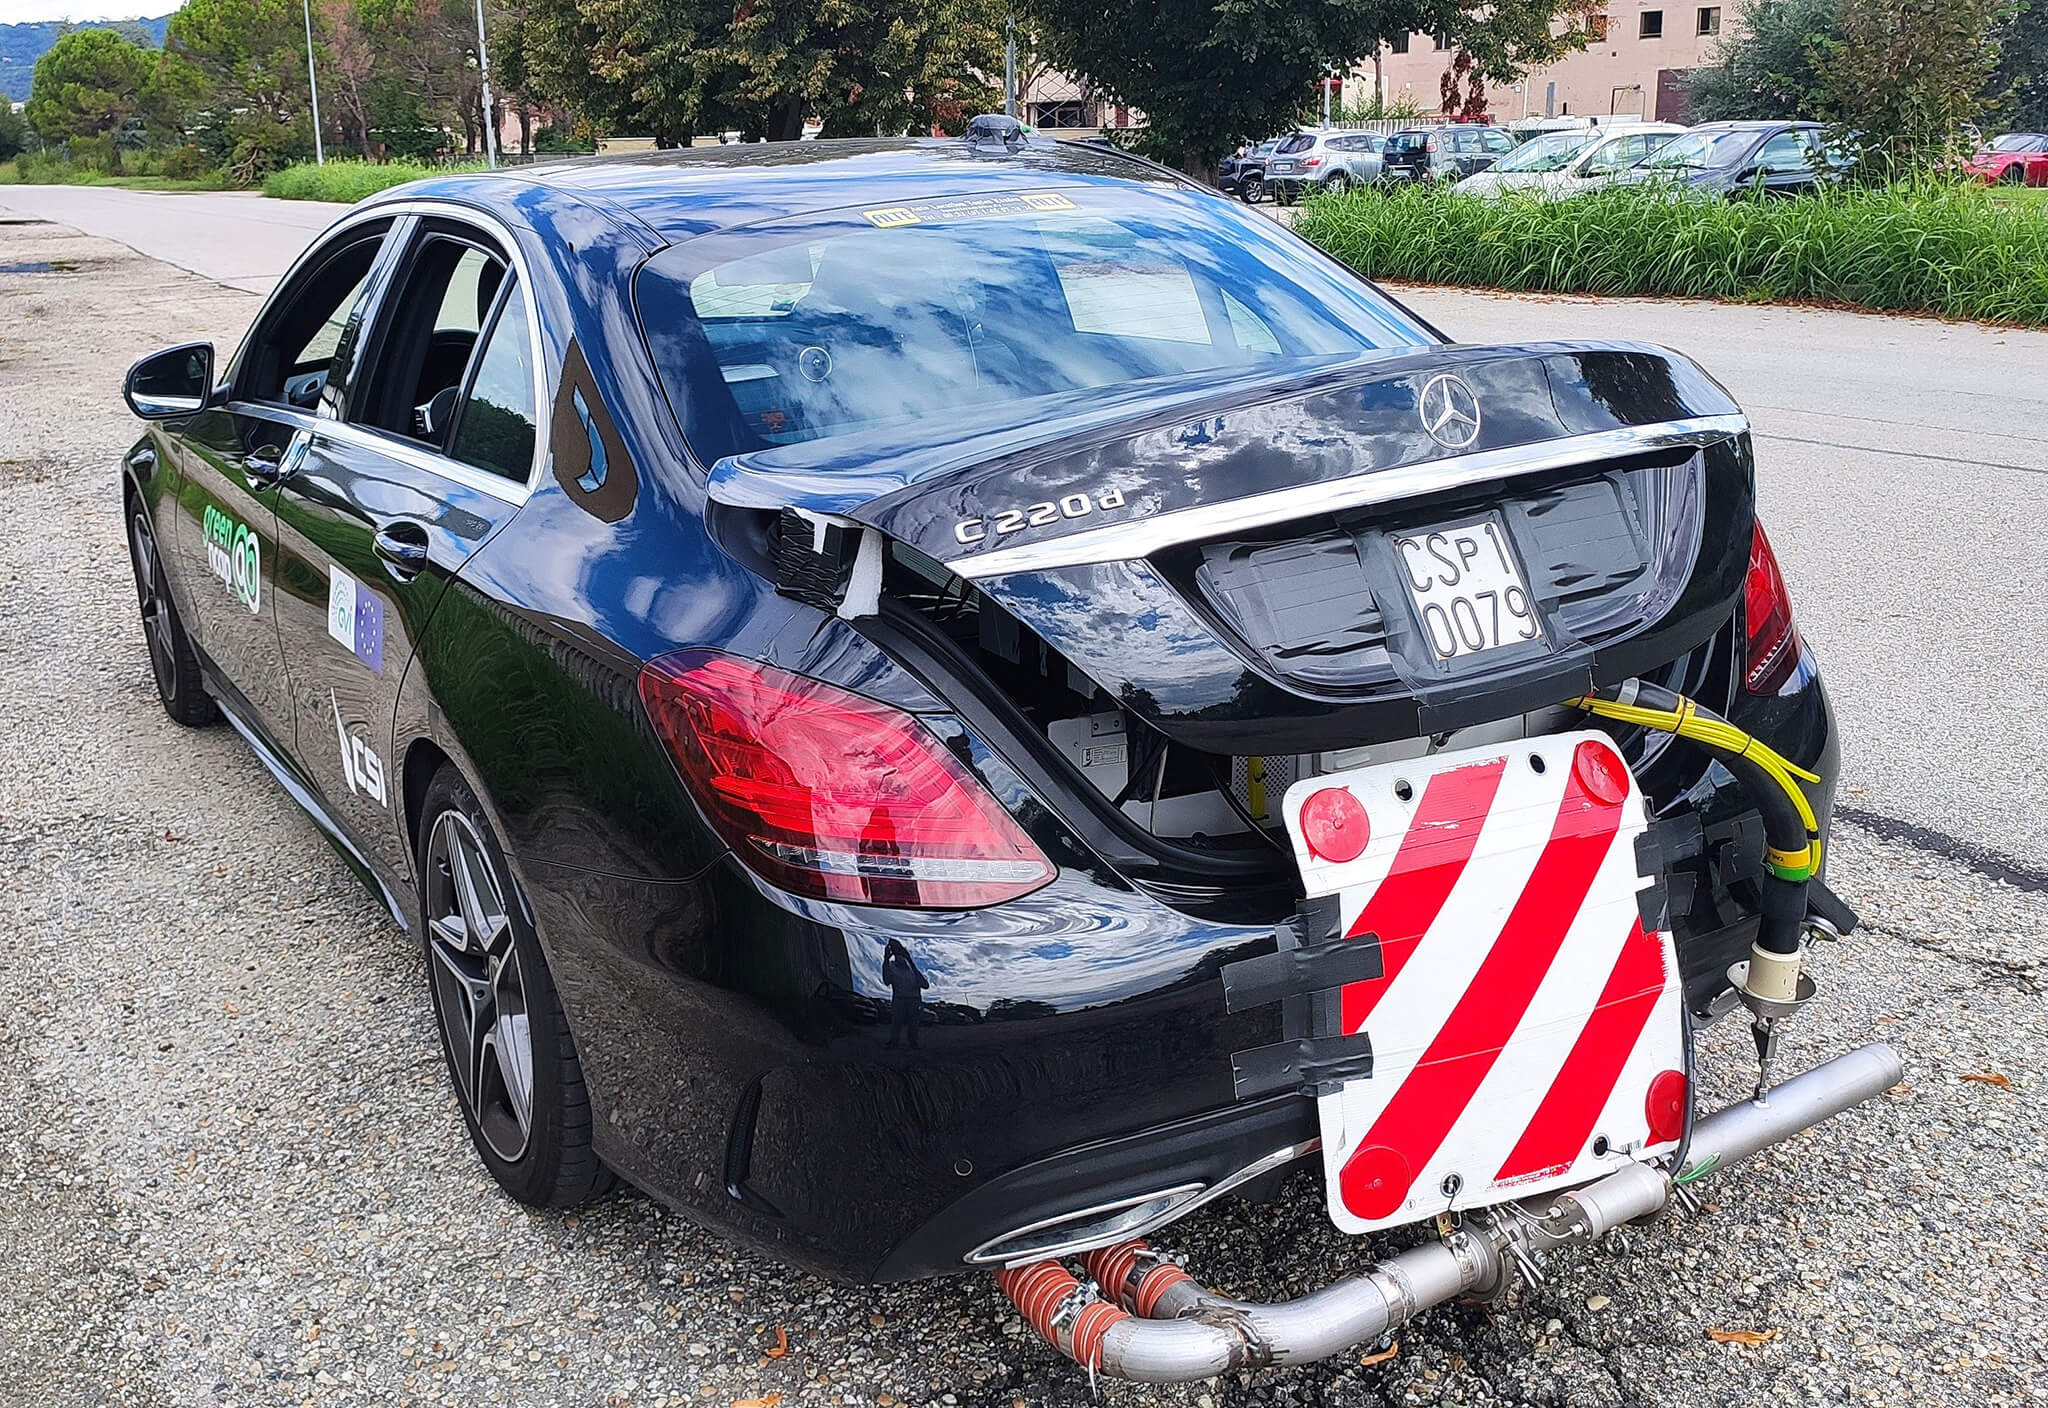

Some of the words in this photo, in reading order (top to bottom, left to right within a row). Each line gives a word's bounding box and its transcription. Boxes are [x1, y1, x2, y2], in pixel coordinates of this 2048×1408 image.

[203, 505, 233, 548] green
[954, 519, 986, 544] C
[1422, 585, 1538, 657] 0079
